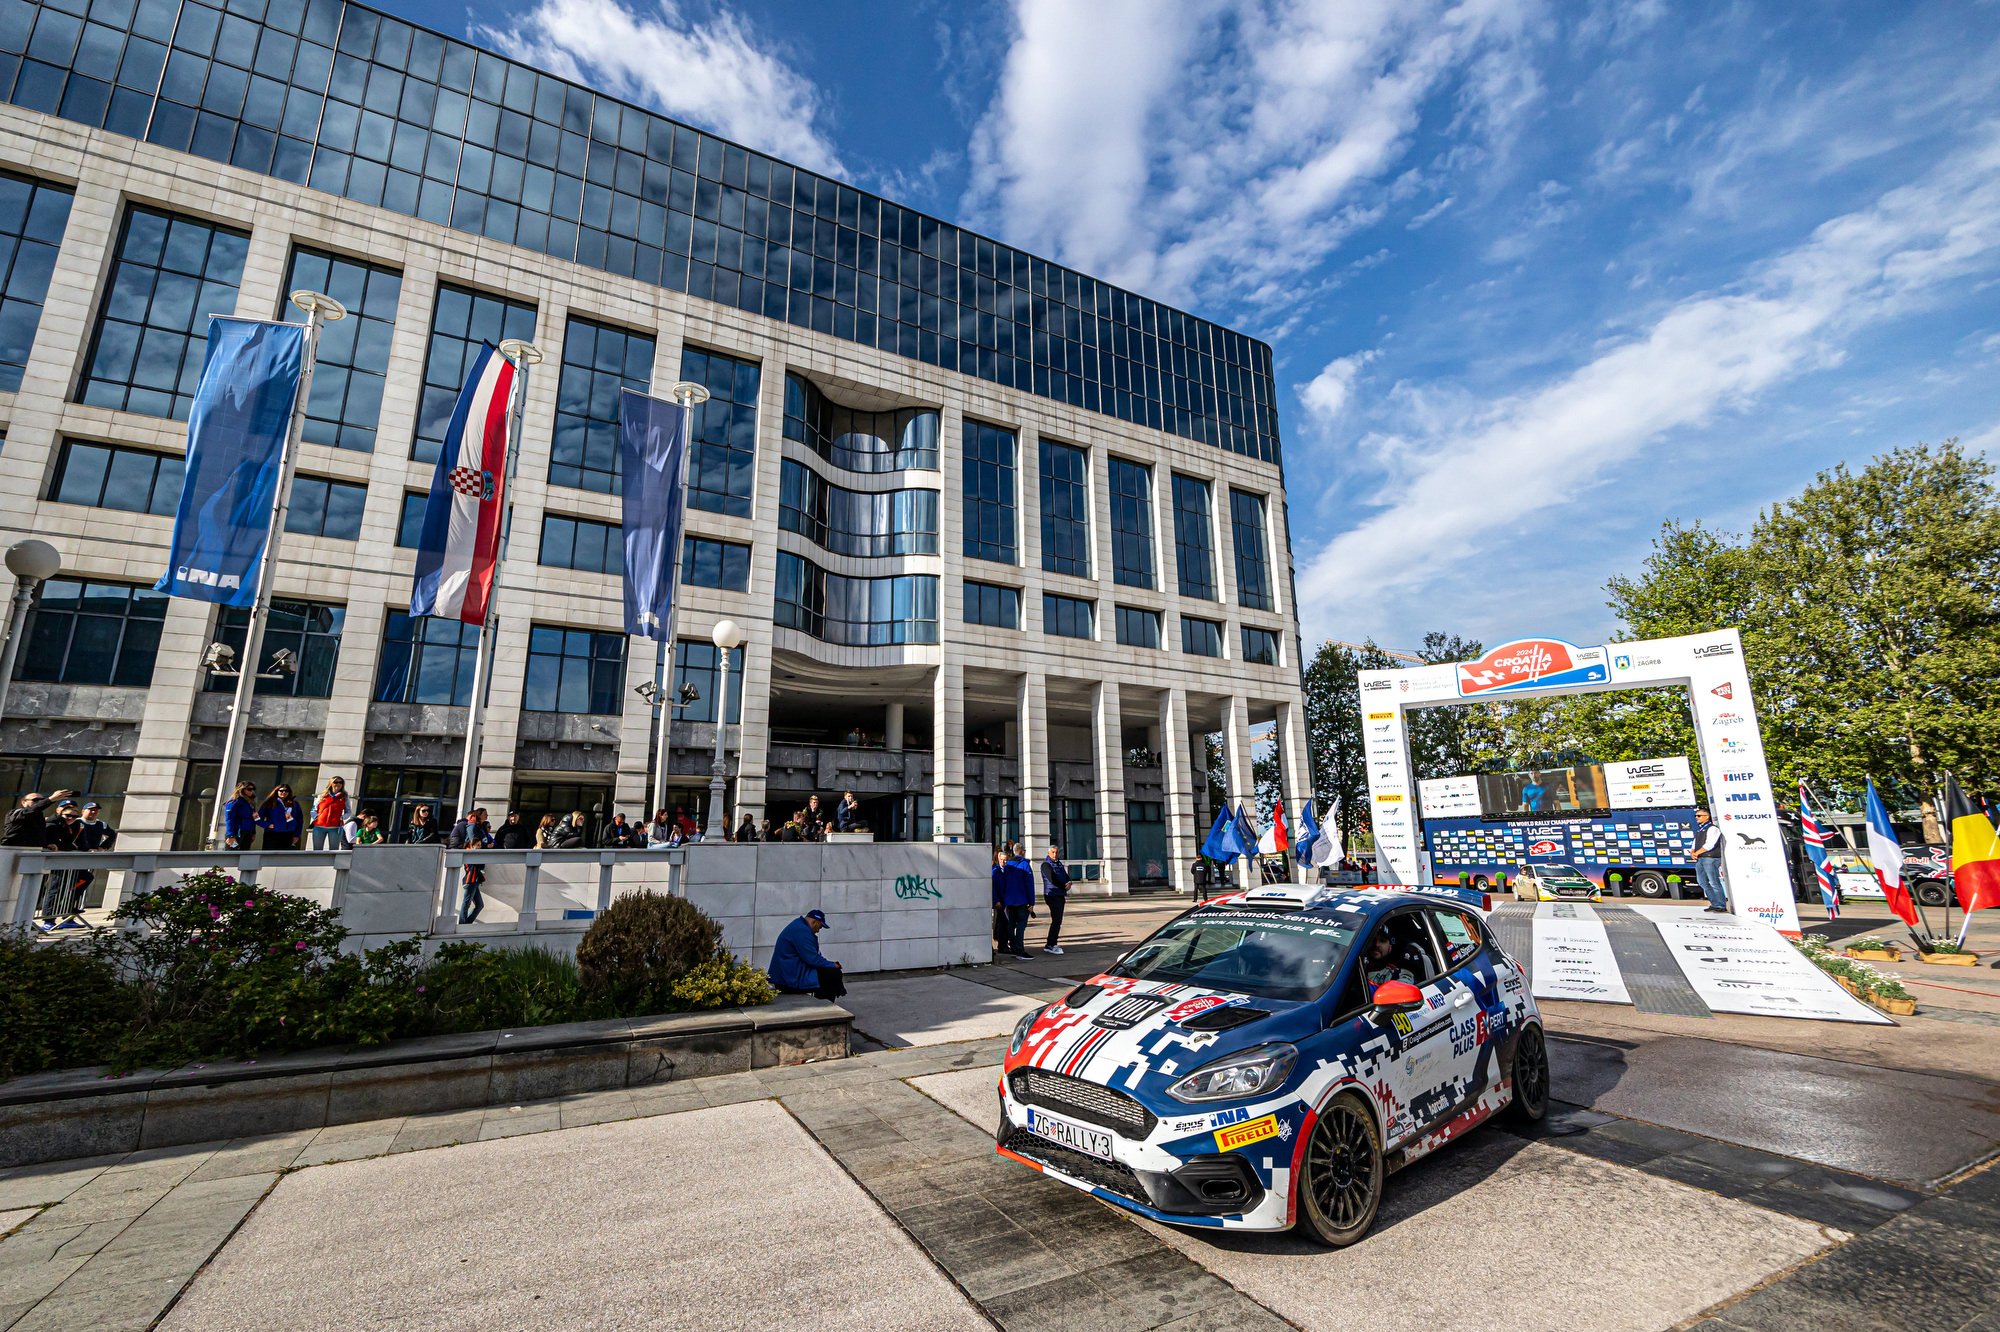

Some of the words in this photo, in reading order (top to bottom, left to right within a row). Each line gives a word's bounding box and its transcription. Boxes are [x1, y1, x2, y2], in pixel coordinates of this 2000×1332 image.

[1693, 643, 1733, 655] WRC
[1494, 649, 1552, 667] CROATIA
[1511, 662, 1551, 677] RALLY
[1363, 680, 1391, 688] WRC
[1712, 716, 1744, 726] Zagreb
[1626, 764, 1665, 774] WRC
[1733, 772, 1754, 781] HEP
[1550, 818, 1592, 826] CHAMPIONSHIP
[1526, 826, 1564, 835] WRC
[1747, 904, 1785, 913] CROATIA
[1190, 911, 1343, 927] www.automatic-servis.hr
[1758, 912, 1784, 920] RALLY
[1281, 924, 1306, 932] FUEL
[1449, 1017, 1476, 1044] CLASS
[1453, 1034, 1474, 1060] PLUS
[1035, 1113, 1050, 1136] ZG
[1220, 1119, 1274, 1148] PIRELLI
